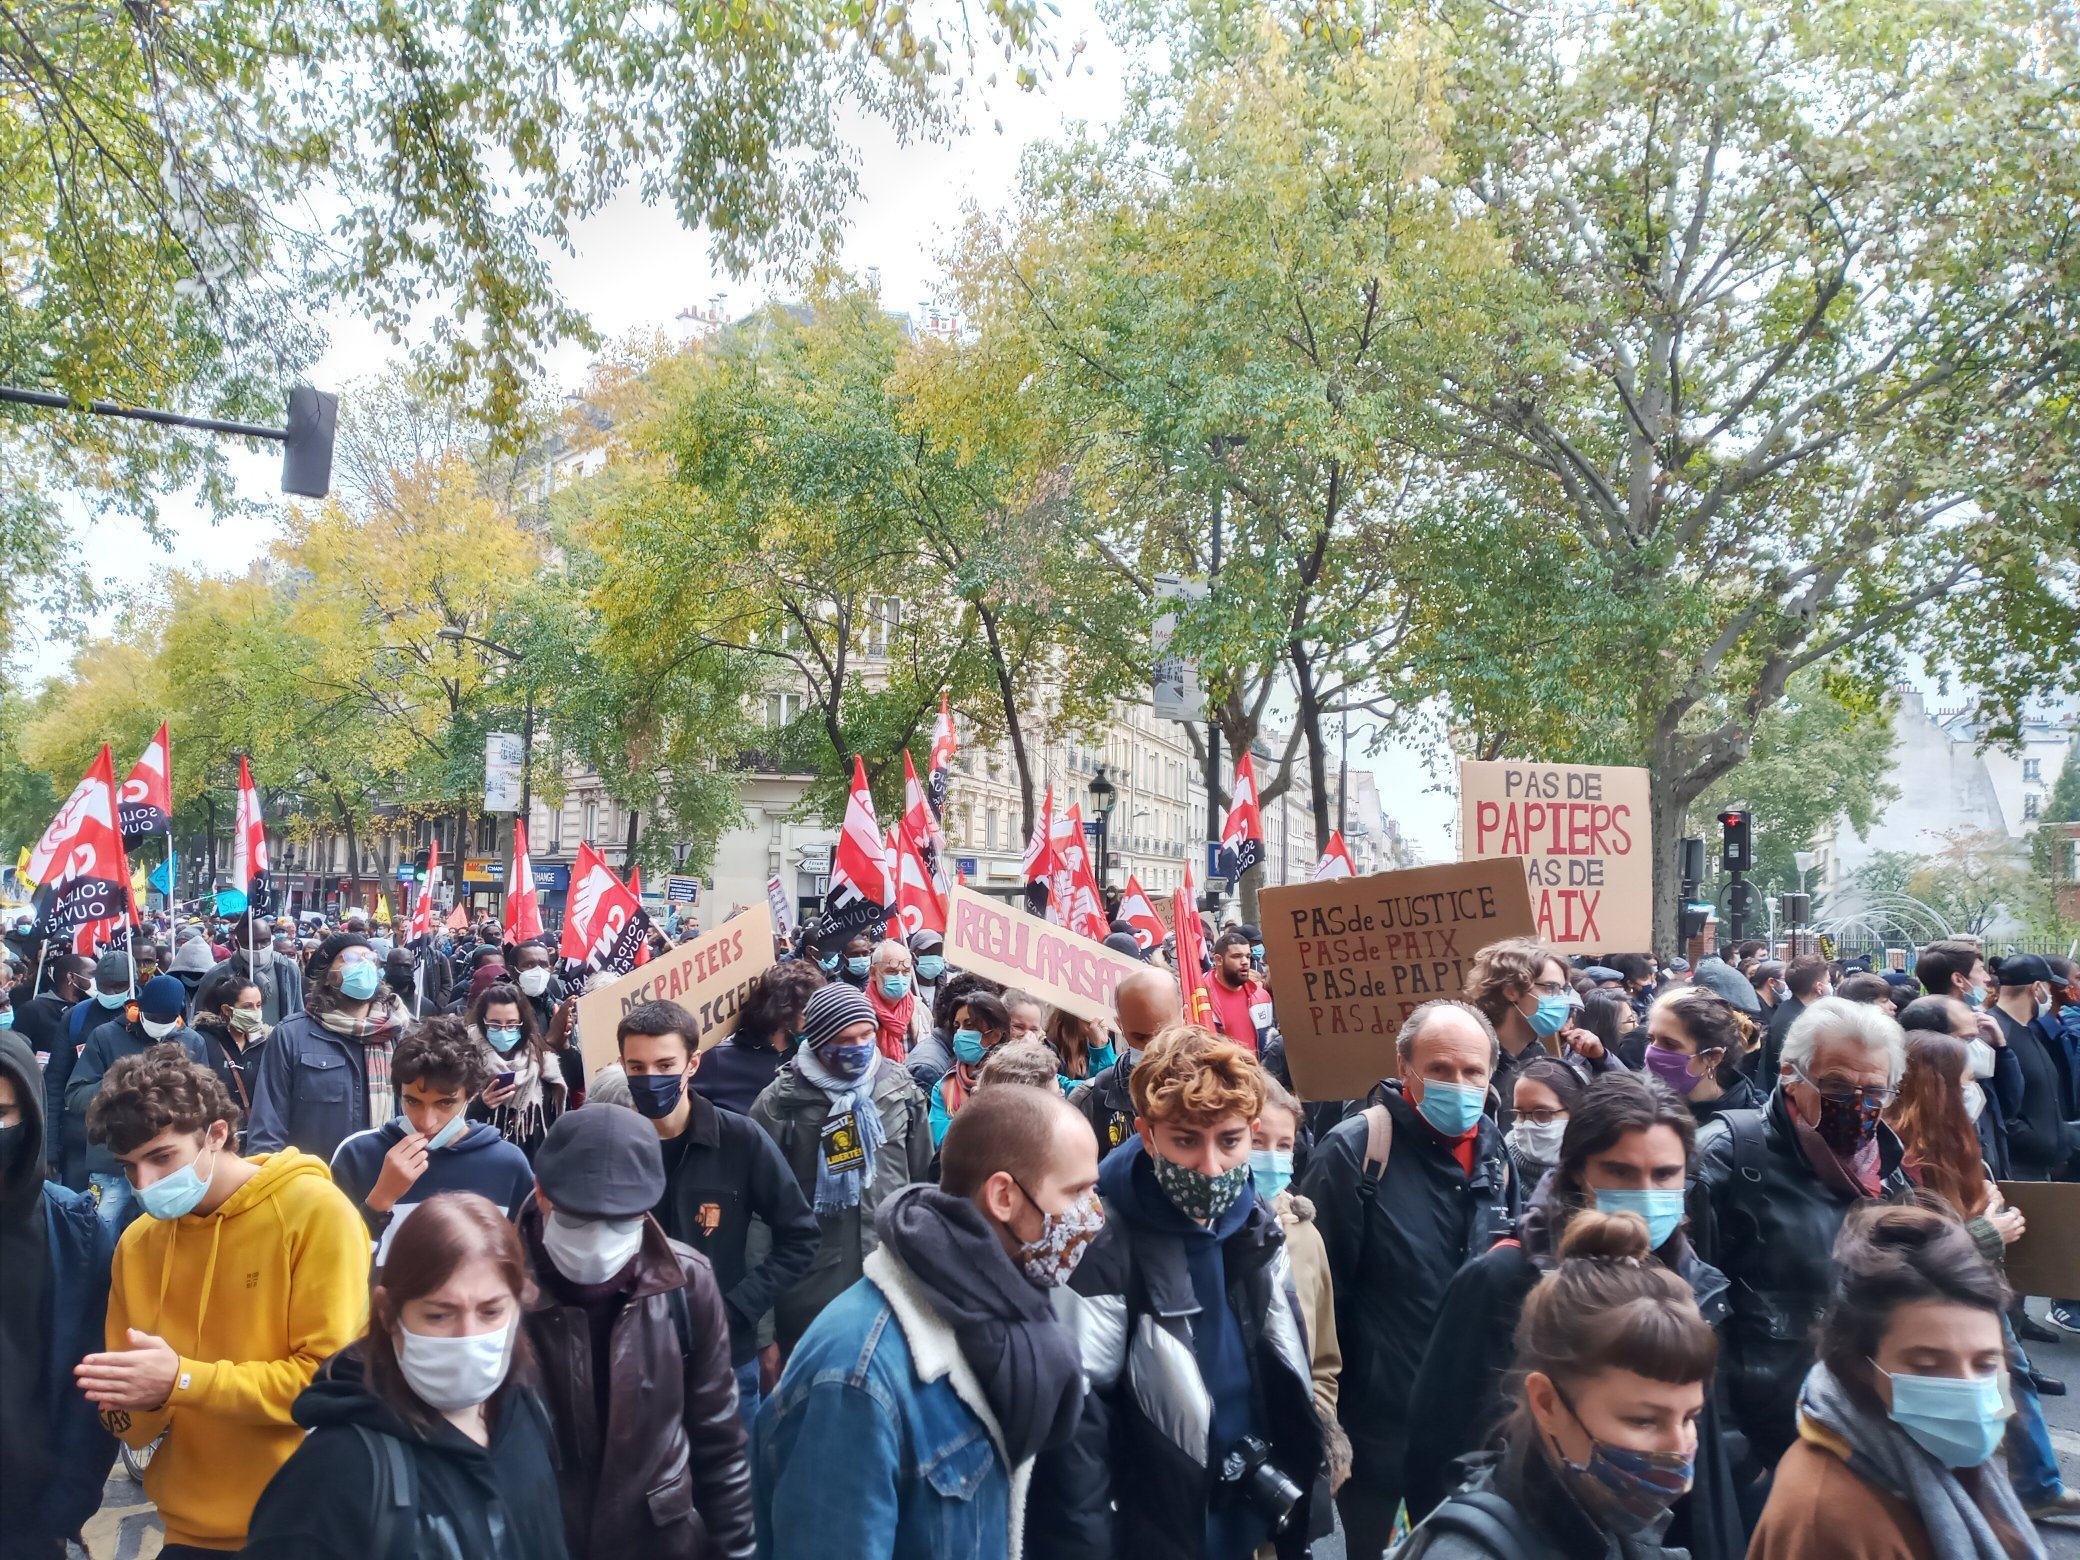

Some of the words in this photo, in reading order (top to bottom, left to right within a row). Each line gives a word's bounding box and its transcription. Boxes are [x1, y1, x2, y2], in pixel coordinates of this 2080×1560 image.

[1506, 770, 1560, 799] PAS
[1567, 772, 1602, 801] DE
[1477, 800, 1632, 856] PAPIERS
[1529, 858, 1561, 887] AS
[1569, 859, 1604, 887] DE
[1378, 887, 1496, 928] JUSTICE
[1537, 889, 1600, 943] AIX
[1385, 928, 1461, 961] PAIX
[653, 929, 744, 1000] PAPIERS
[1391, 957, 1476, 995] PAPI
